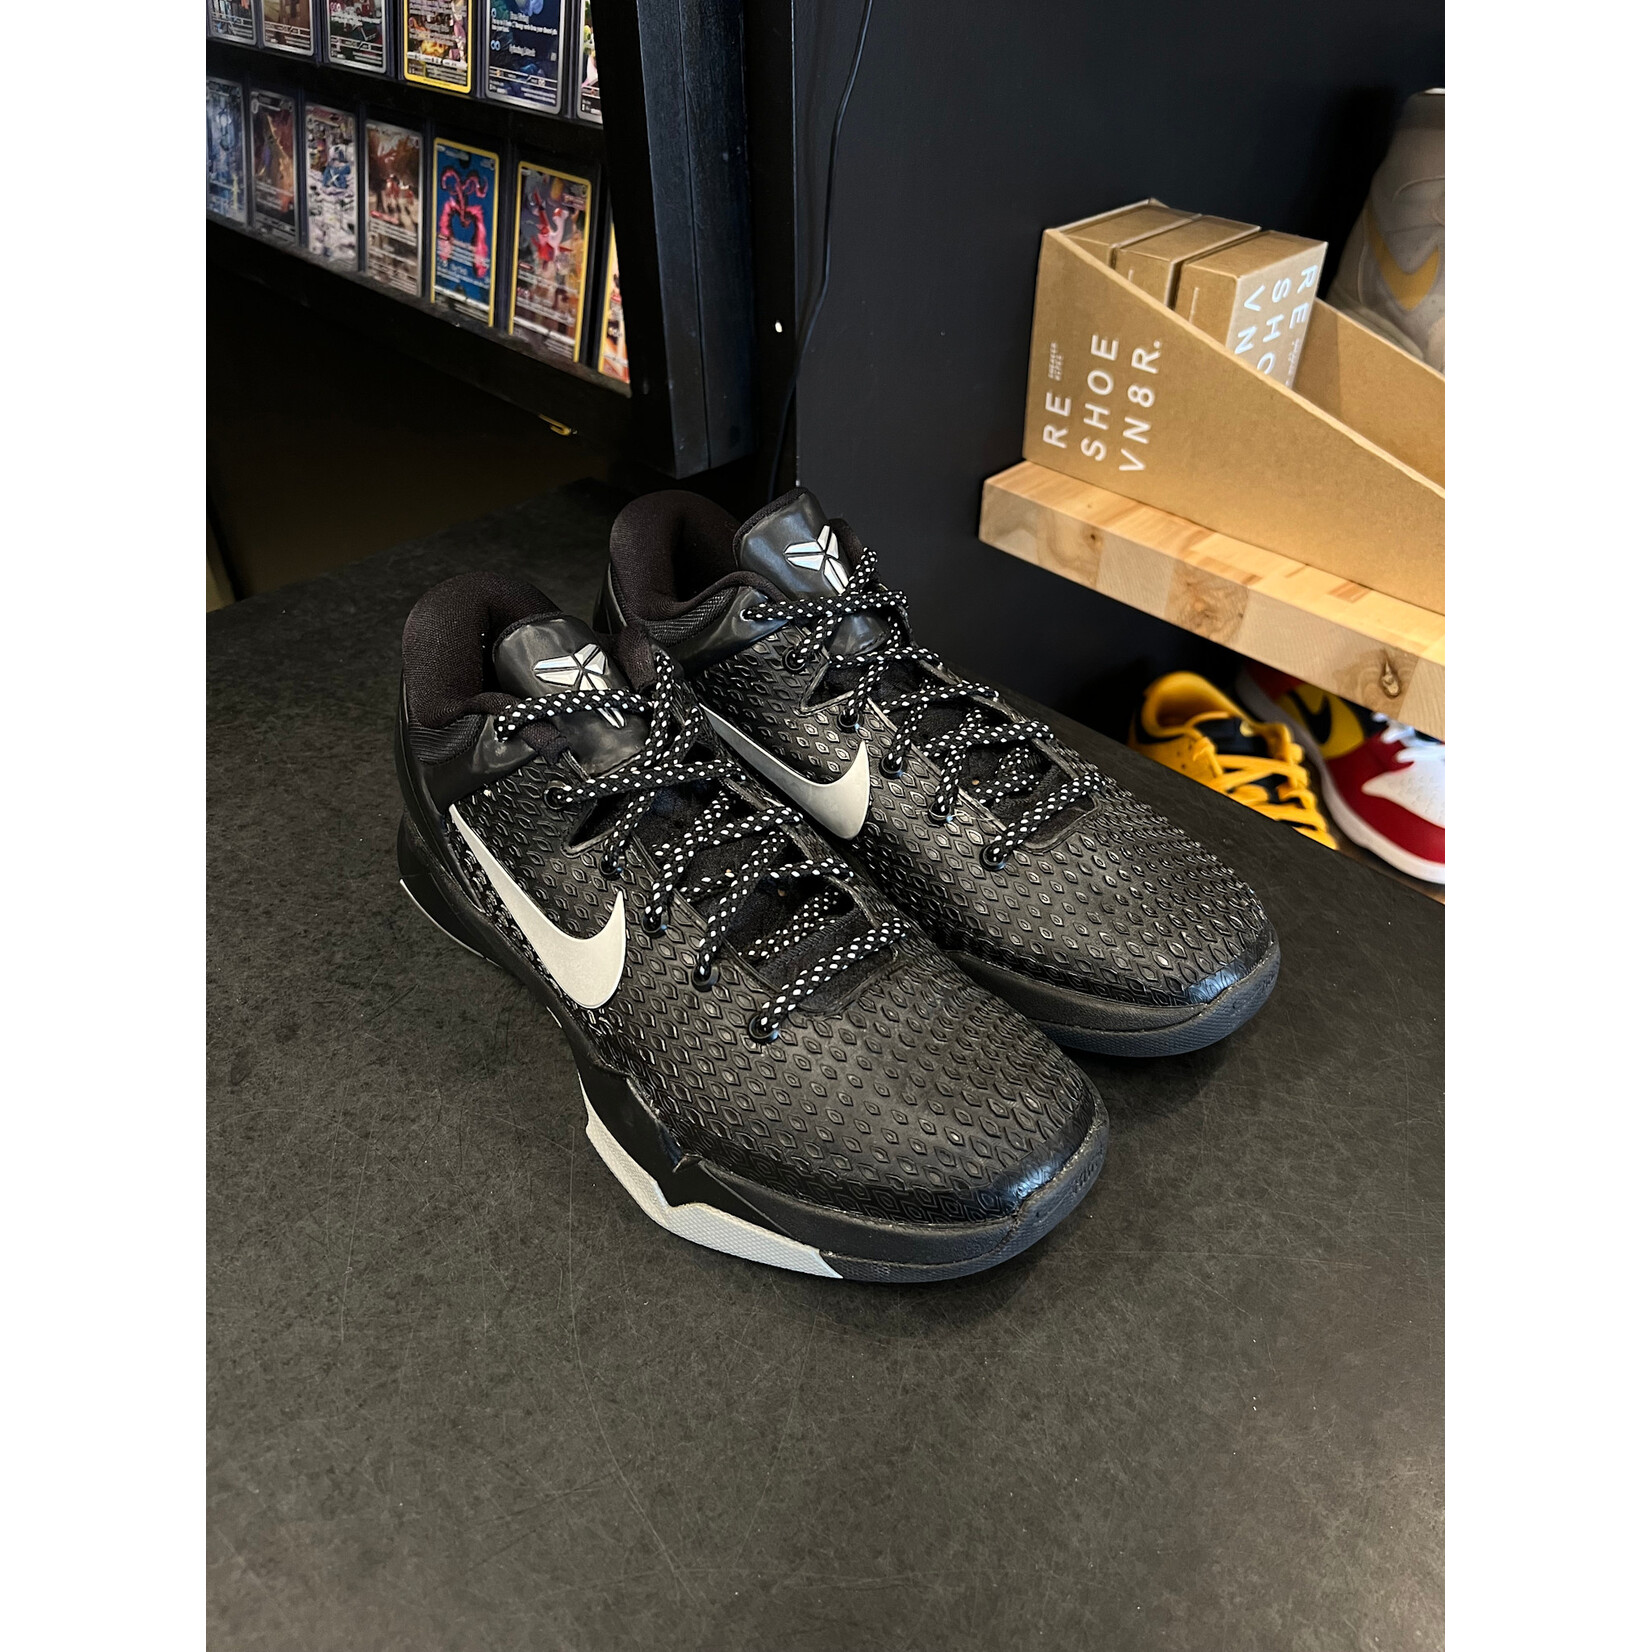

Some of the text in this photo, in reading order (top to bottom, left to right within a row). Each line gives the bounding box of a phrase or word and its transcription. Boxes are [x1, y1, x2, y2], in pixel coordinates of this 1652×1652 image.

[1290, 264, 1317, 329] RE
[1043, 392, 1071, 448] RE
[1081, 333, 1119, 461] SHOE
[1119, 341, 1162, 473] VN8R.
